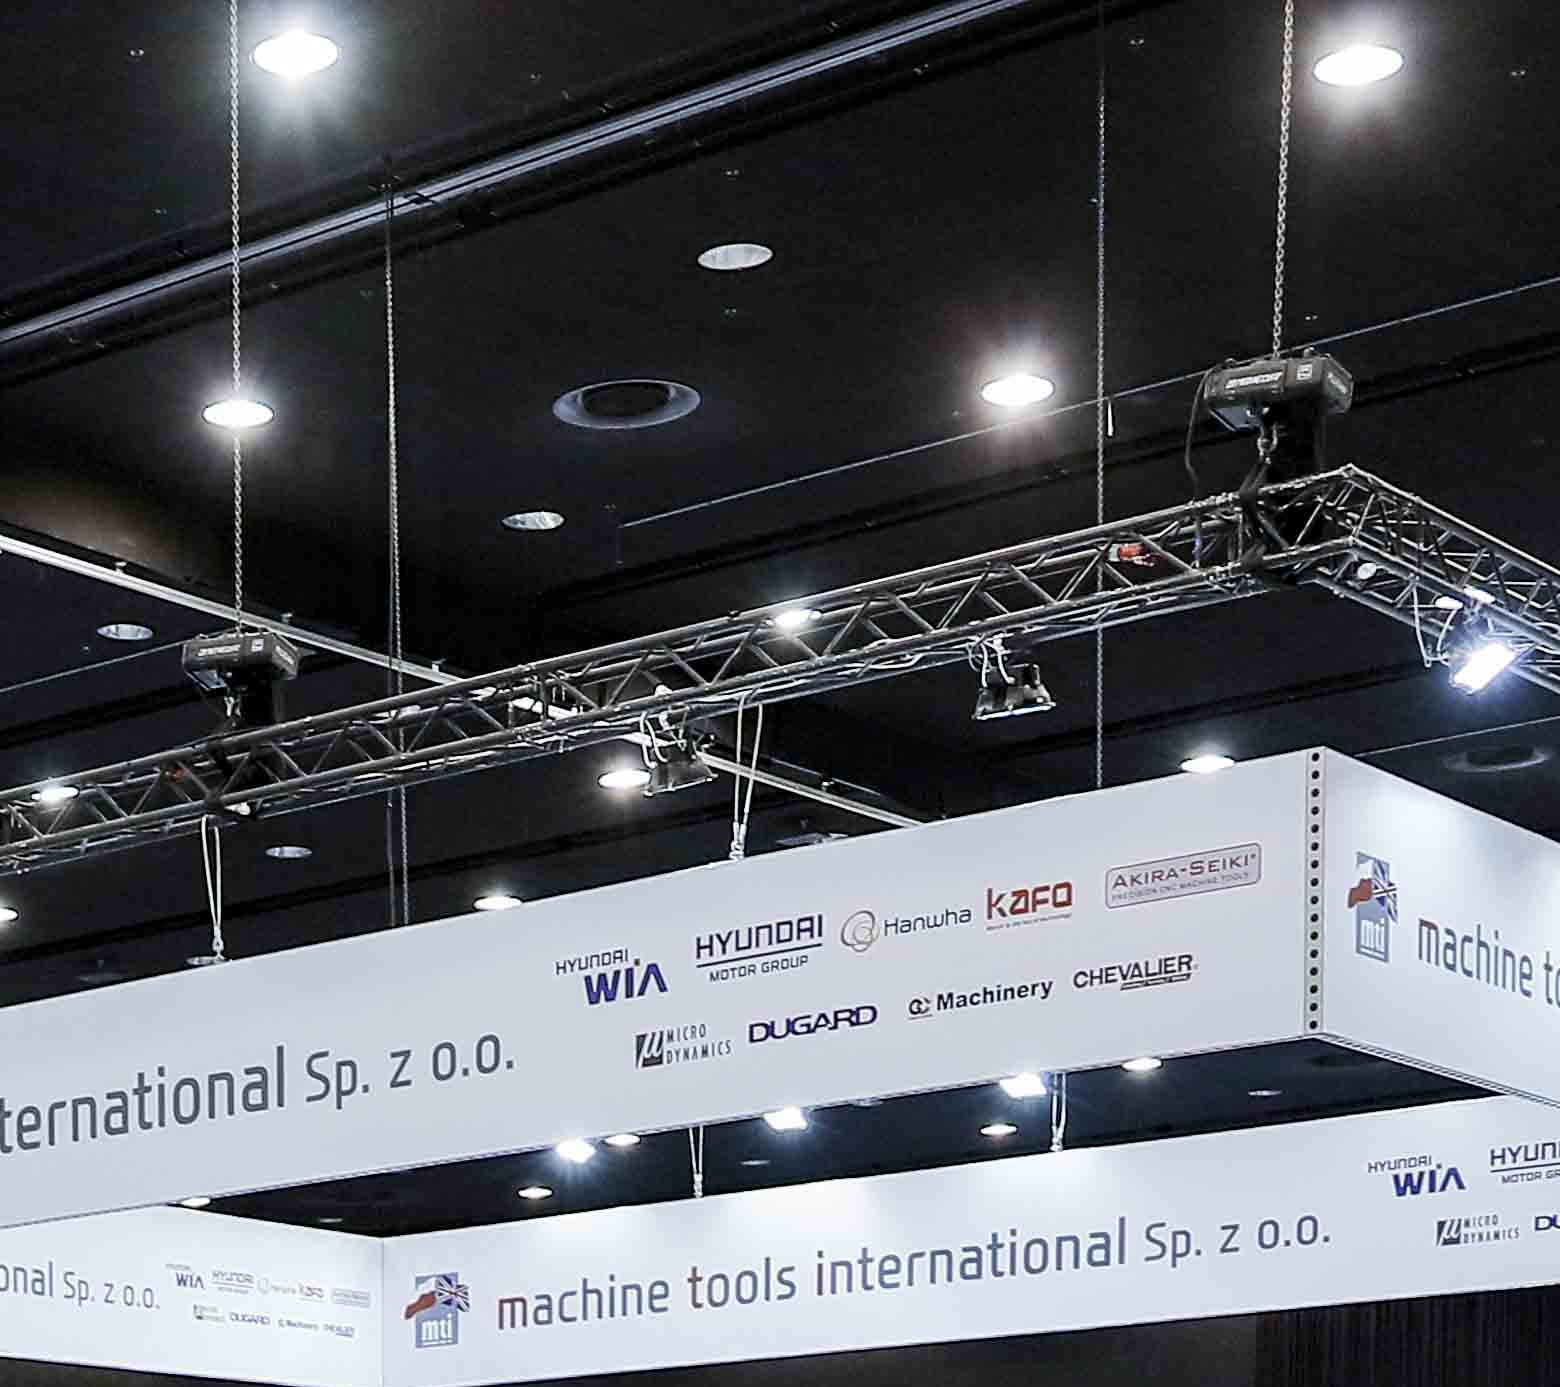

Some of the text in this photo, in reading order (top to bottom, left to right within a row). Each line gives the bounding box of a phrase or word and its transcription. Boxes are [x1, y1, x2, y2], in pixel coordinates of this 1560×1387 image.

[696, 914, 823, 959] HYUNDAI
[884, 905, 973, 937] Hanwha
[556, 948, 628, 975] HYUNDAI
[709, 955, 808, 982] MOTOR GROUP
[1073, 954, 1194, 988] CHEVALIER
[1418, 918, 1533, 998] machine
[936, 980, 1054, 1012] Machinery
[666, 1023, 707, 1044] MICRO
[748, 1004, 878, 1043] DUGARD
[665, 1039, 732, 1066] DYNAMICS
[306, 1050, 370, 1110] Sp.
[390, 1049, 412, 1088] z
[432, 1033, 514, 1082] o.o.
[1367, 1155, 1432, 1173] HYUNDAI
[1502, 1171, 1542, 1184] MOTOR
[498, 1214, 1331, 1331] machine tools international Sp. z o.o.
[63, 1272, 95, 1306] Sp.
[104, 1282, 115, 1304] z
[122, 1285, 161, 1310] o.o.
